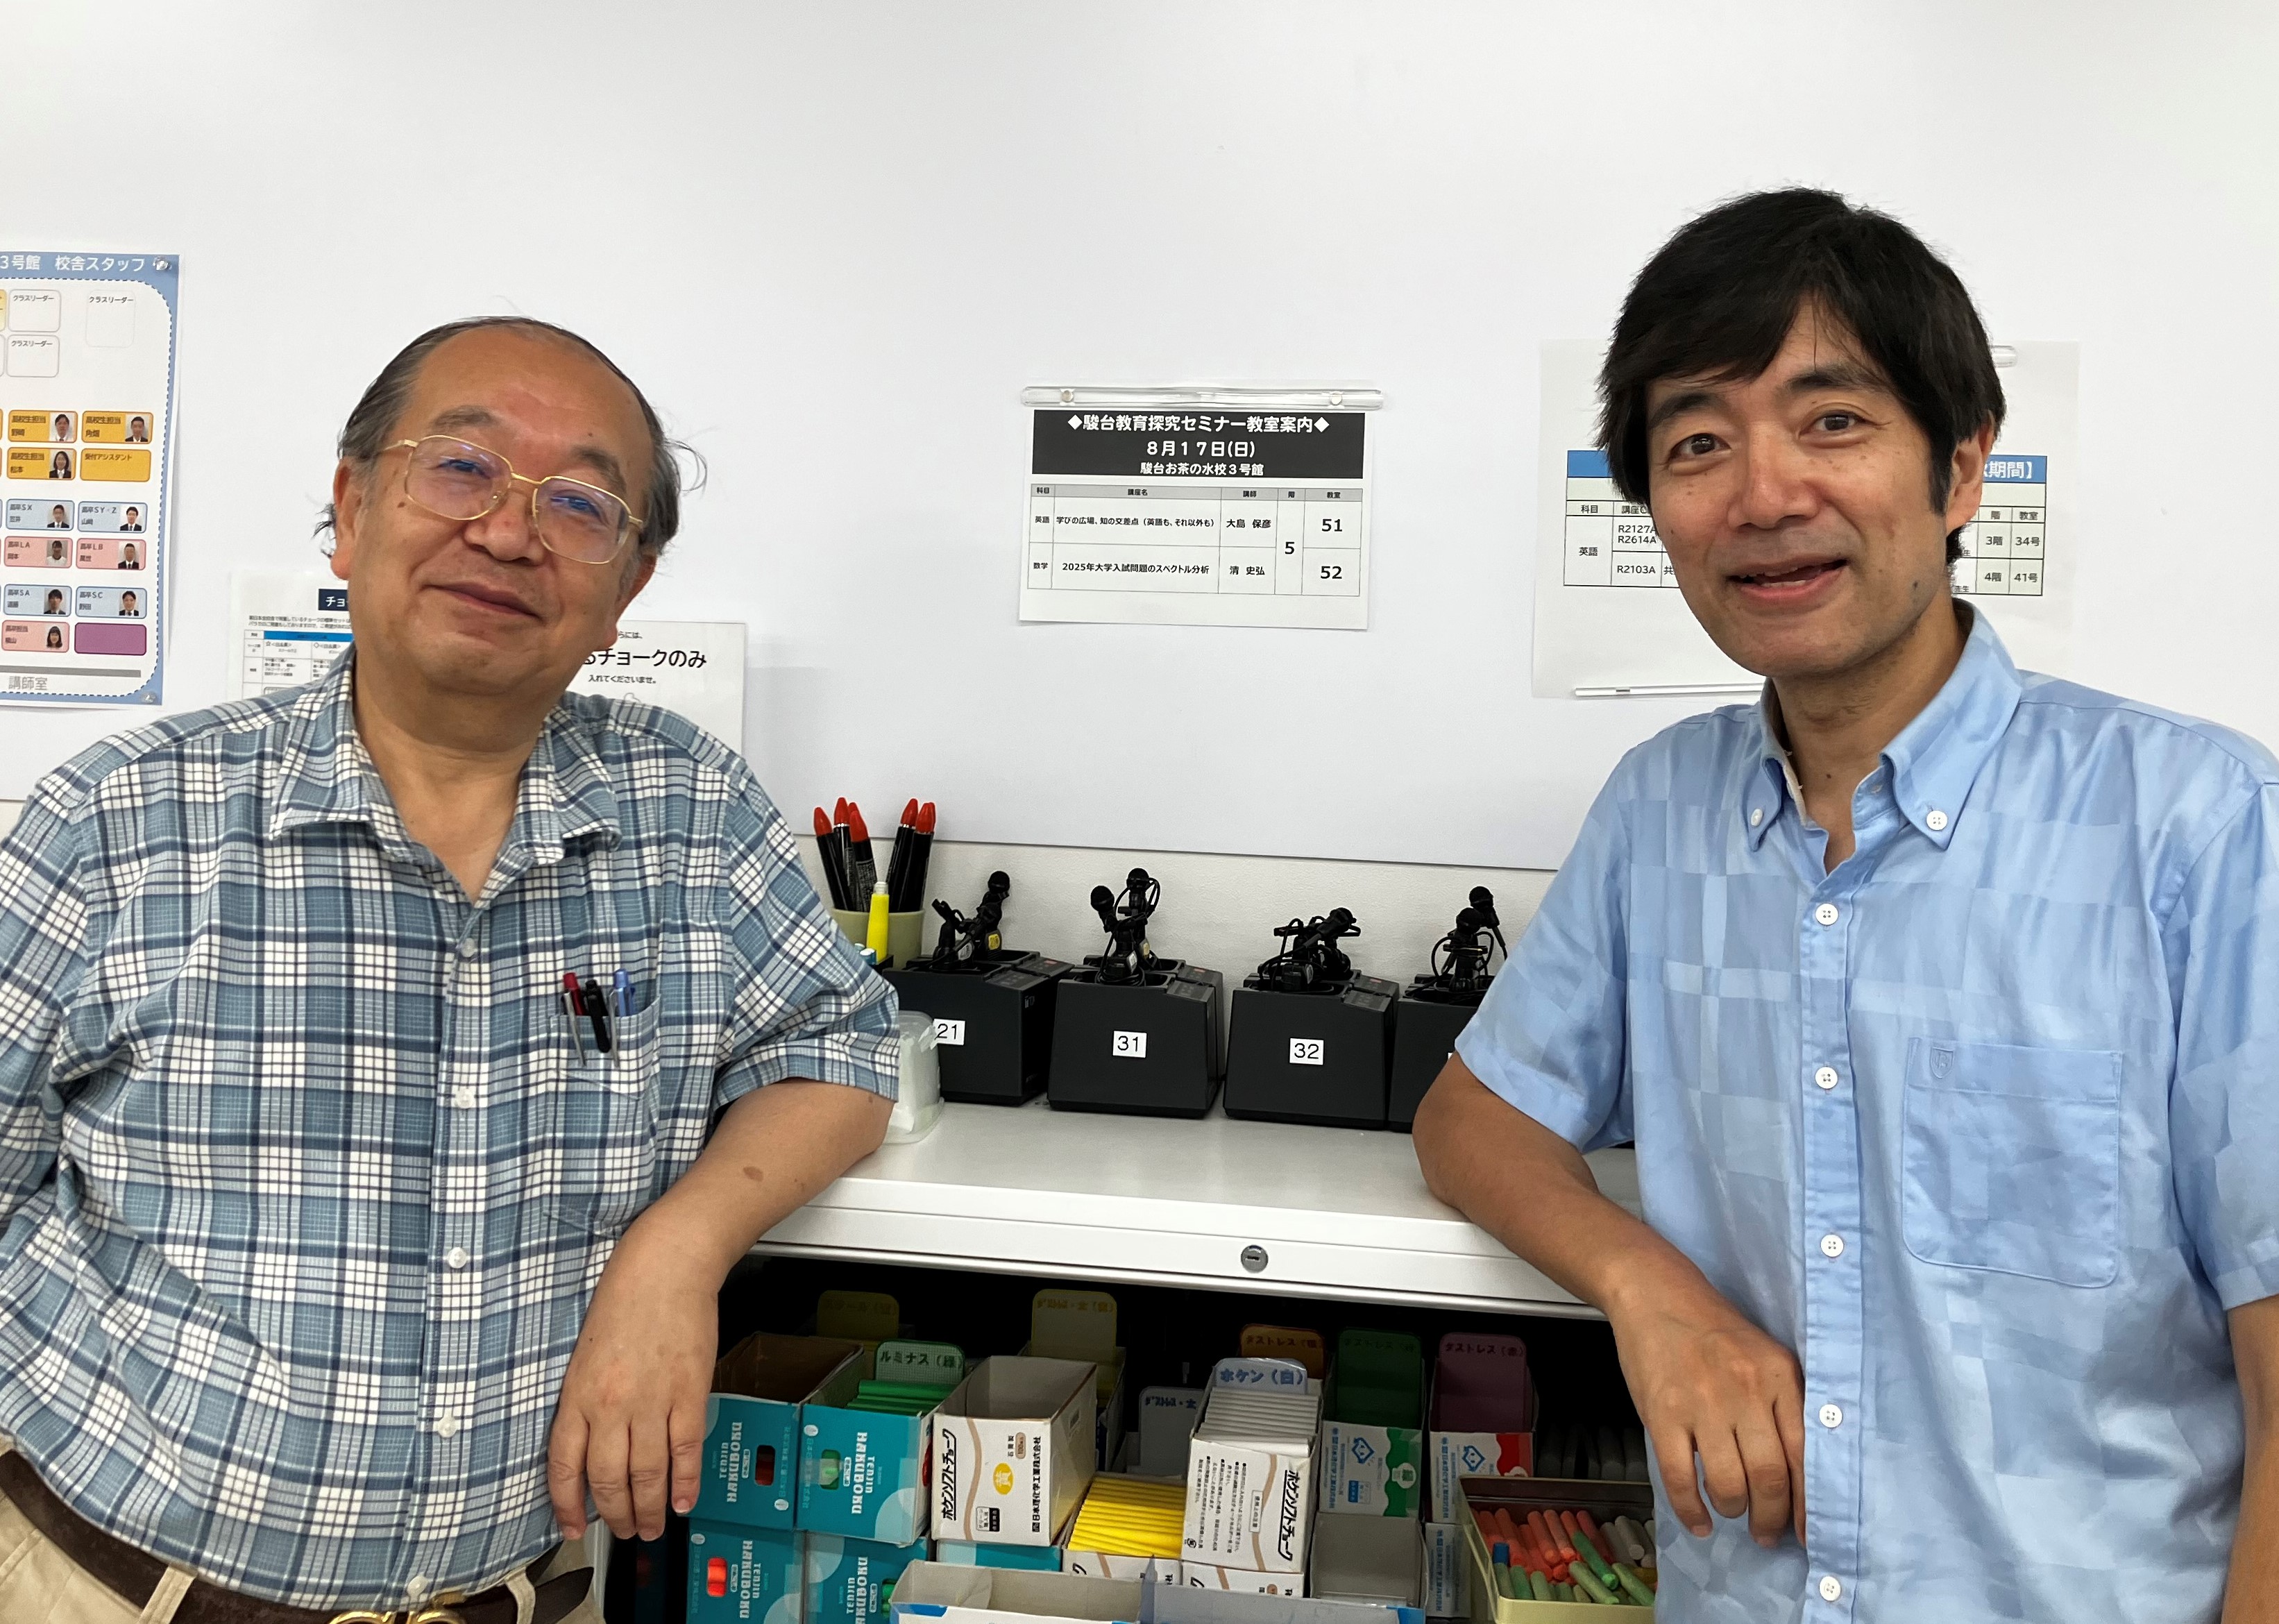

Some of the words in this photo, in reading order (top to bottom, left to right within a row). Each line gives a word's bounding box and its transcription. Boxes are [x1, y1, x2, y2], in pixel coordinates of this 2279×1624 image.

[56, 255, 145, 271] 校舎スタッフ
[1083, 414, 1313, 434] 駿台教育探究セミナー教室案内
[85, 453, 133, 462] 受付アシスタント
[1140, 462, 1264, 477] 駿台お茶の水校3号館
[1581, 505, 1598, 514] 科目
[1991, 511, 2001, 520] 階
[1035, 516, 1050, 525] 英語
[2019, 511, 2038, 521] 教室
[1226, 519, 1246, 528] 大島
[1252, 519, 1271, 529] 保彦
[1322, 519, 1343, 532] 51
[1618, 525, 1656, 533] R2127A
[1986, 536, 2003, 545] 3階
[2015, 537, 2040, 546] 34号
[1285, 541, 1295, 555] 5
[1579, 546, 1598, 557] 英語
[1033, 561, 1048, 570] 数学
[1062, 563, 1210, 575] 2025年大学入試問題のスペクトル分析
[1230, 566, 1239, 575] 清
[1246, 566, 1265, 576] 史弘
[1617, 566, 1656, 574] R2103A
[1320, 566, 1343, 580] 52
[1984, 573, 2001, 582] 4階
[2014, 573, 2037, 582] 41号
[325, 596, 348, 607] チョ
[8, 676, 48, 691] 講師室
[938, 1022, 960, 1040] 21
[1118, 1035, 1140, 1052] 31
[1294, 1042, 1319, 1060] 32
[1220, 1367, 1304, 1387] ホケン（白）
[727, 1421, 743, 1503] HAKUBOKU
[852, 1432, 868, 1514] HAKUBOKU
[941, 1428, 956, 1521] ホケンソフトチョーク
[995, 1471, 1012, 1487] 黄
[1278, 1470, 1301, 1562] ホケンソフトチョーク
[739, 1540, 753, 1619] HAKUBOKU
